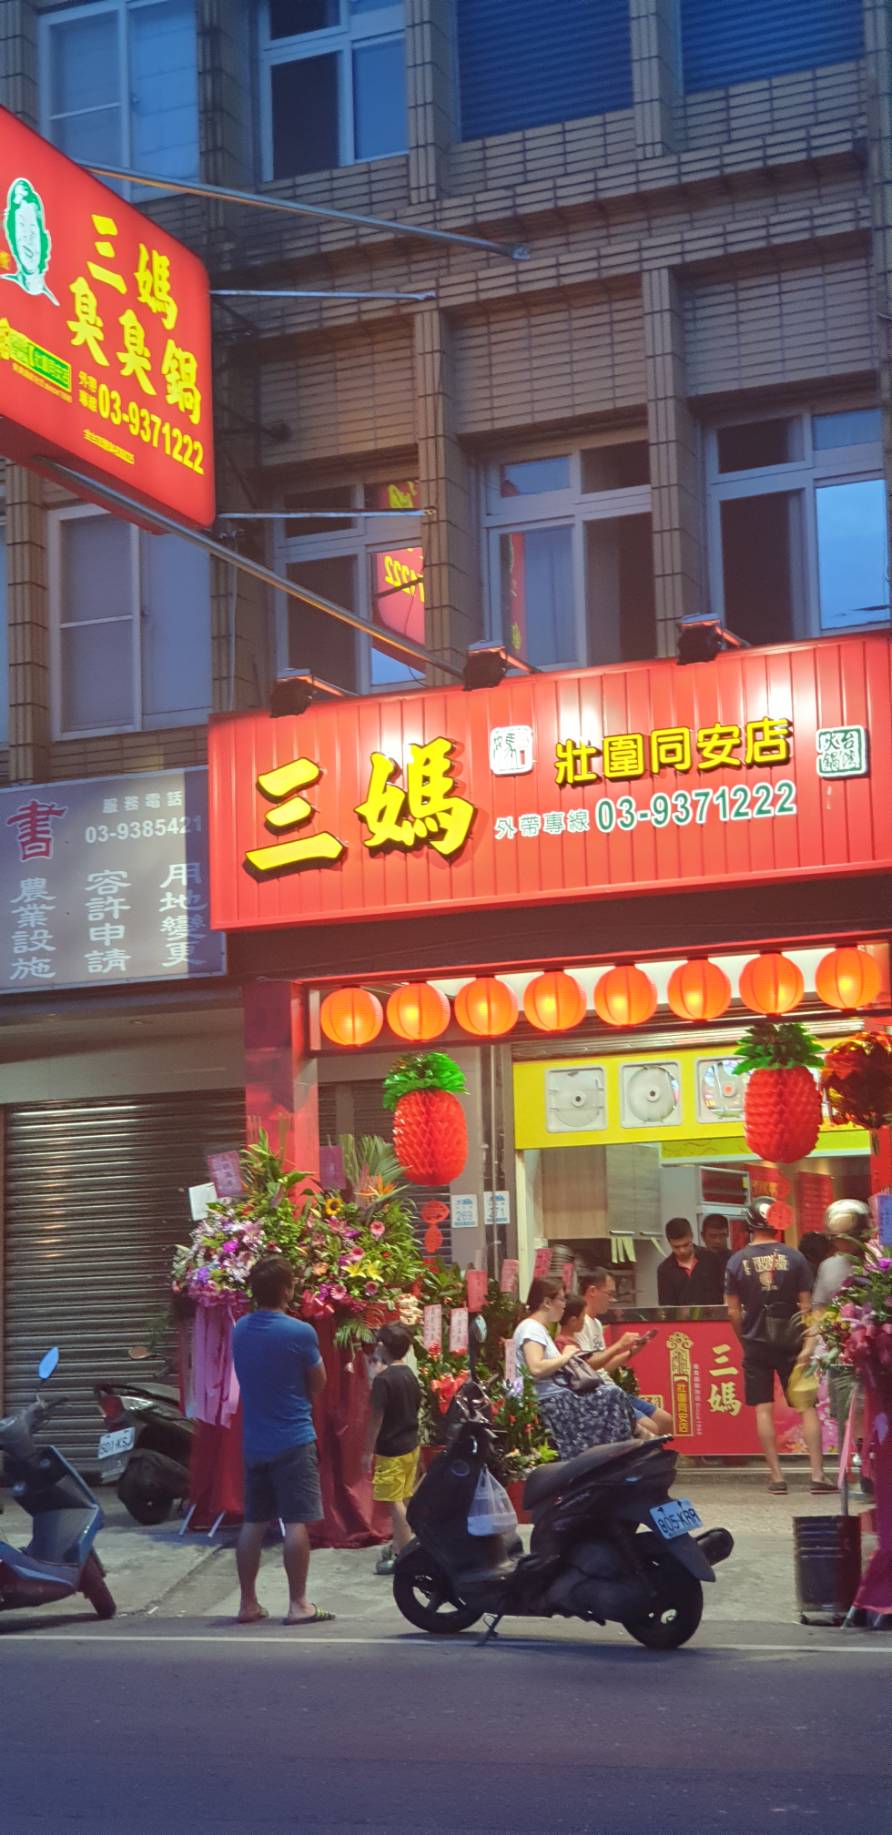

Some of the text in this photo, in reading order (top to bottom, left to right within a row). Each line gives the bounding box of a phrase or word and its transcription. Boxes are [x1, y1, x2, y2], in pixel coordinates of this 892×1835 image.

[87, 214, 178, 330] 三媽
[66, 276, 202, 425] 臭臭鍋
[98, 383, 204, 475] 03-9371222
[554, 716, 790, 785] 壯圍同安店
[7, 799, 68, 863] 書
[85, 815, 202, 843] 03-9385421
[245, 736, 476, 872] 三媽
[495, 808, 590, 840] 外帶專線
[596, 780, 797, 832] 03-9371222
[10, 877, 56, 980] 農業設施
[84, 869, 131, 974] 容許申請
[159, 863, 207, 967] 用地變更
[707, 1343, 742, 1417] 三媽
